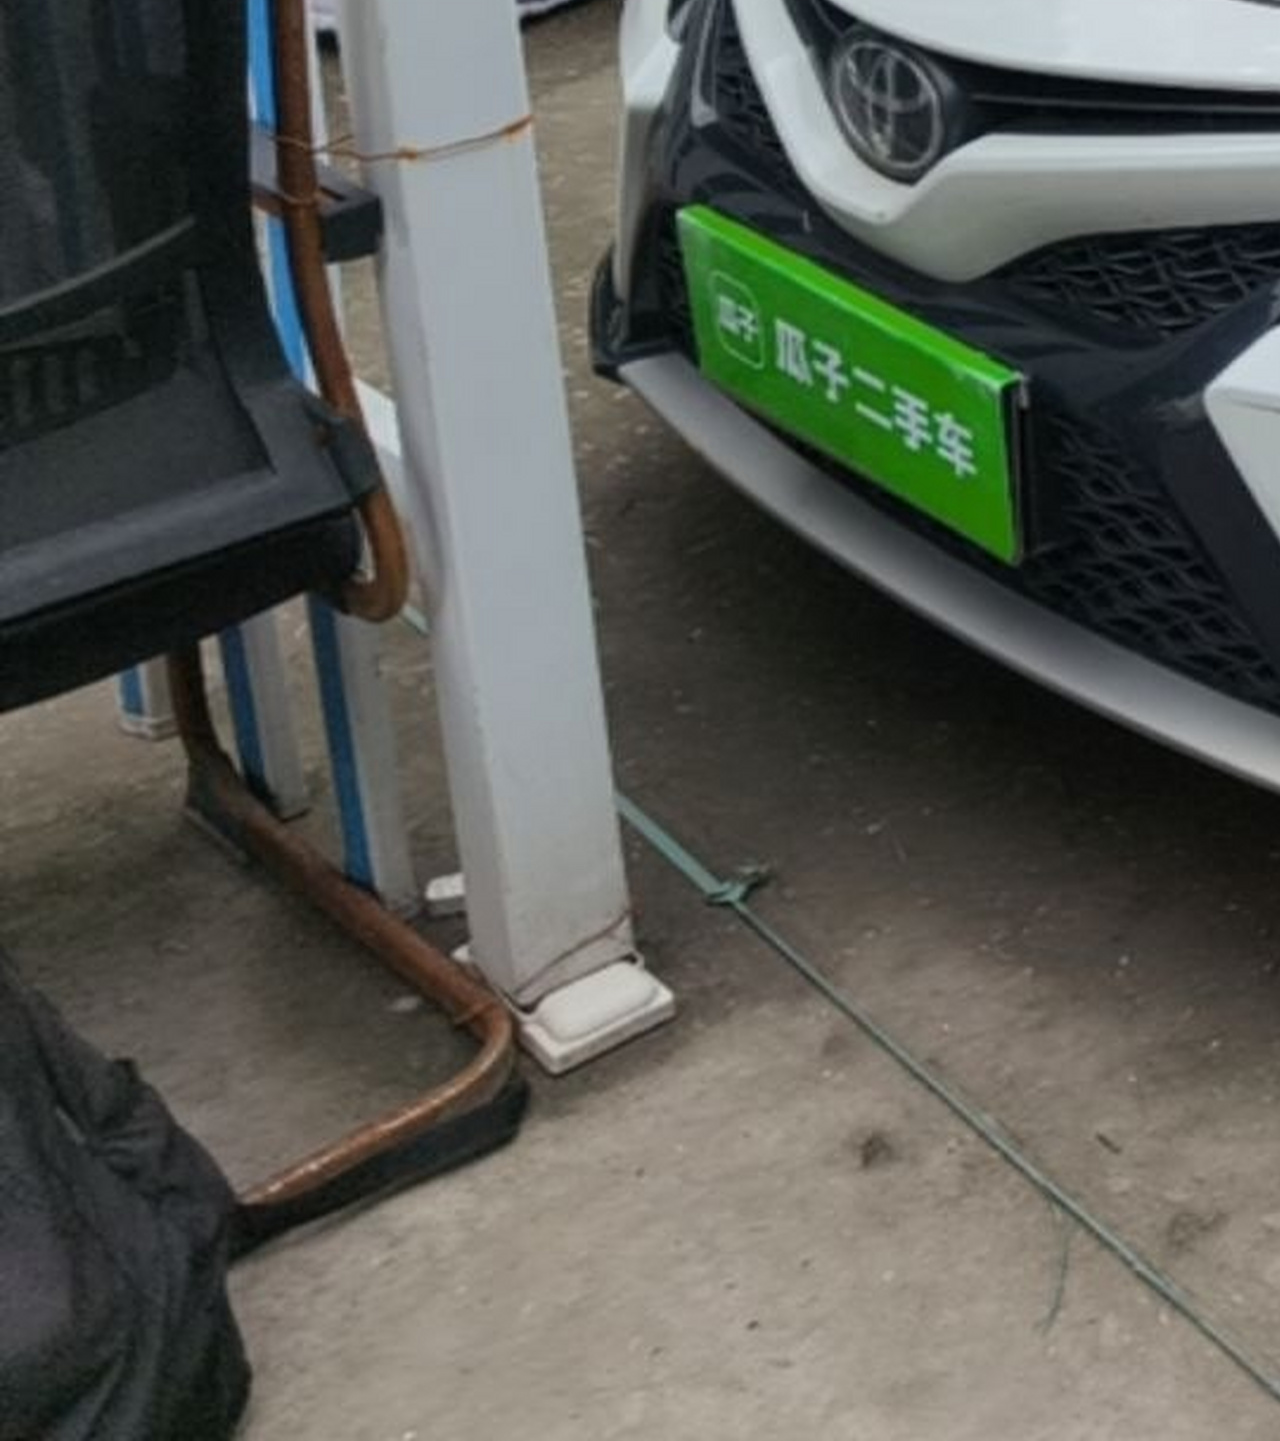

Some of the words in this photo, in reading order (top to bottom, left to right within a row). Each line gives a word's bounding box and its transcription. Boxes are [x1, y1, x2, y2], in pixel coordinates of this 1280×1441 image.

[775, 317, 977, 479] 瓜子二手车
